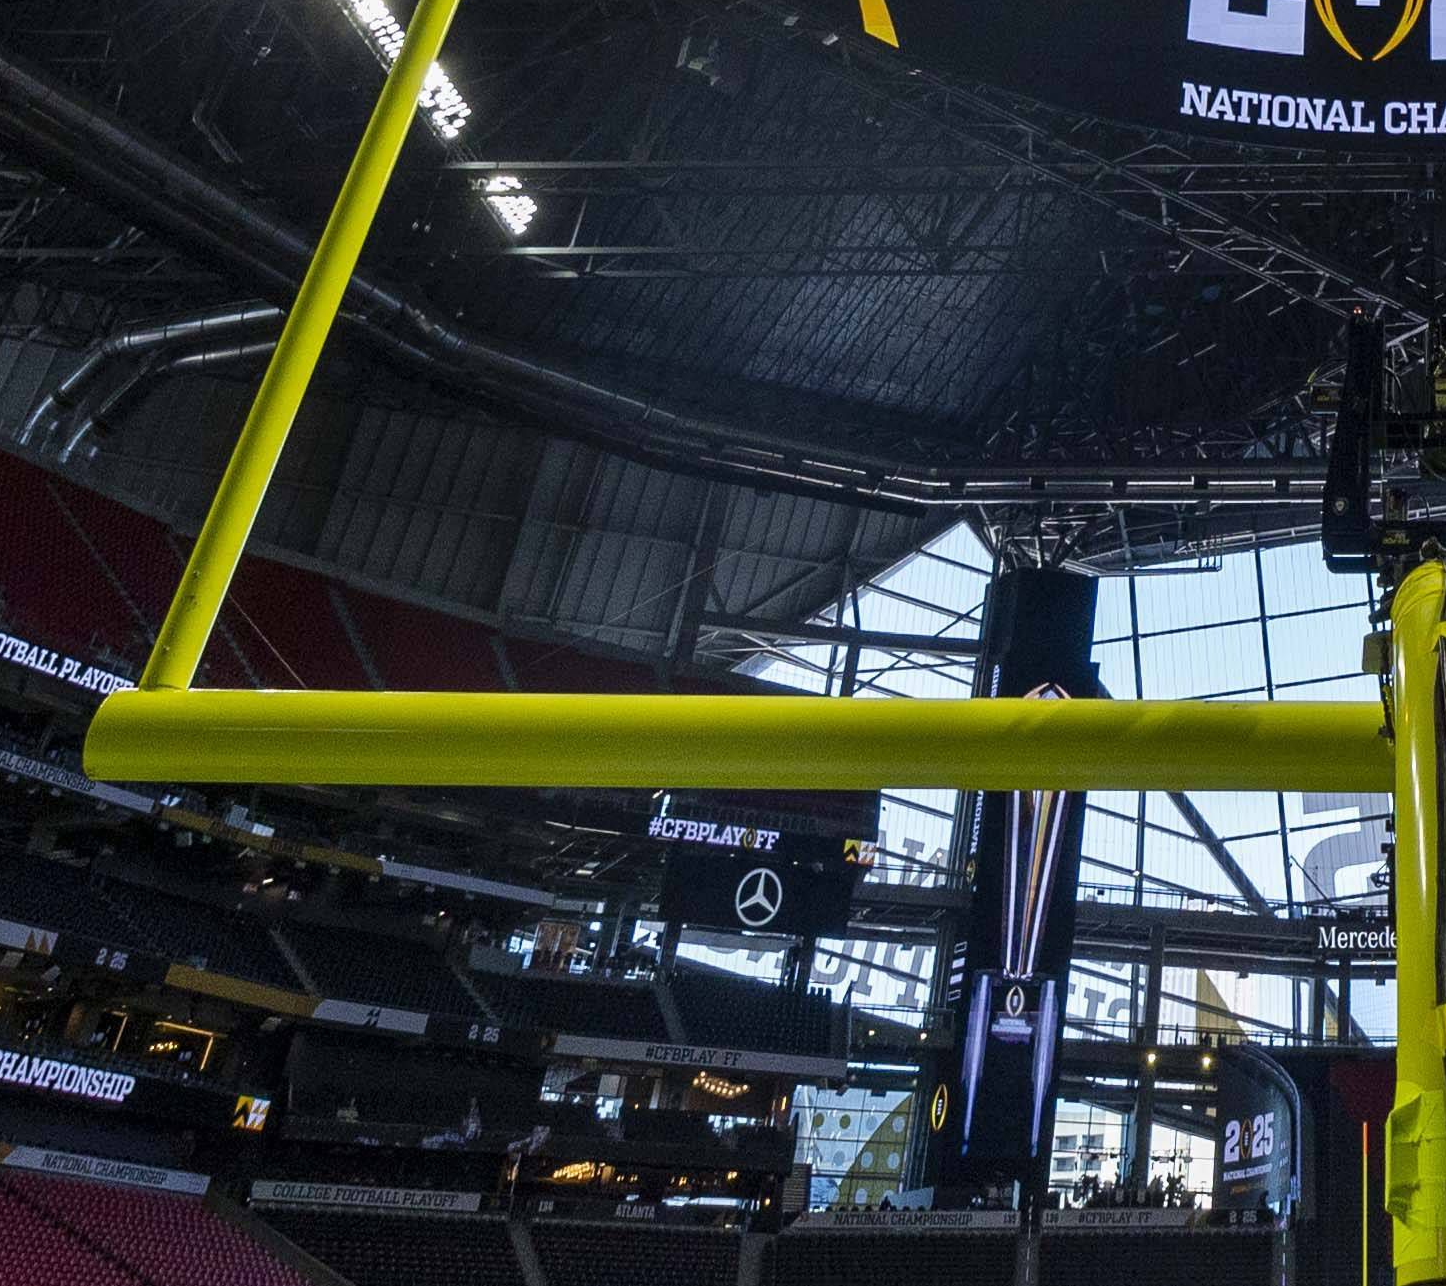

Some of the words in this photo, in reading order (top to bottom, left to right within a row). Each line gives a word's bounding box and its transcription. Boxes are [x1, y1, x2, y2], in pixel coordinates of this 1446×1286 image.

[1180, 82, 1375, 134] NATIONAL
[1318, 925, 1398, 949] Mercede
[94, 947, 130, 973] 225
[466, 1024, 501, 1044] 225
[645, 1045, 742, 1066] #CFBPLAYFF
[41, 1153, 96, 1178] NATIONAL
[92, 1160, 168, 1186] CHAMPIONSHIP
[272, 1183, 333, 1201] COLLEGE
[334, 1187, 400, 1205] FOOTBALL
[400, 1192, 459, 1208] PLAYOFF
[834, 1213, 889, 1226] NATIONAL
[890, 1213, 973, 1227] CHAMPIONSHIP
